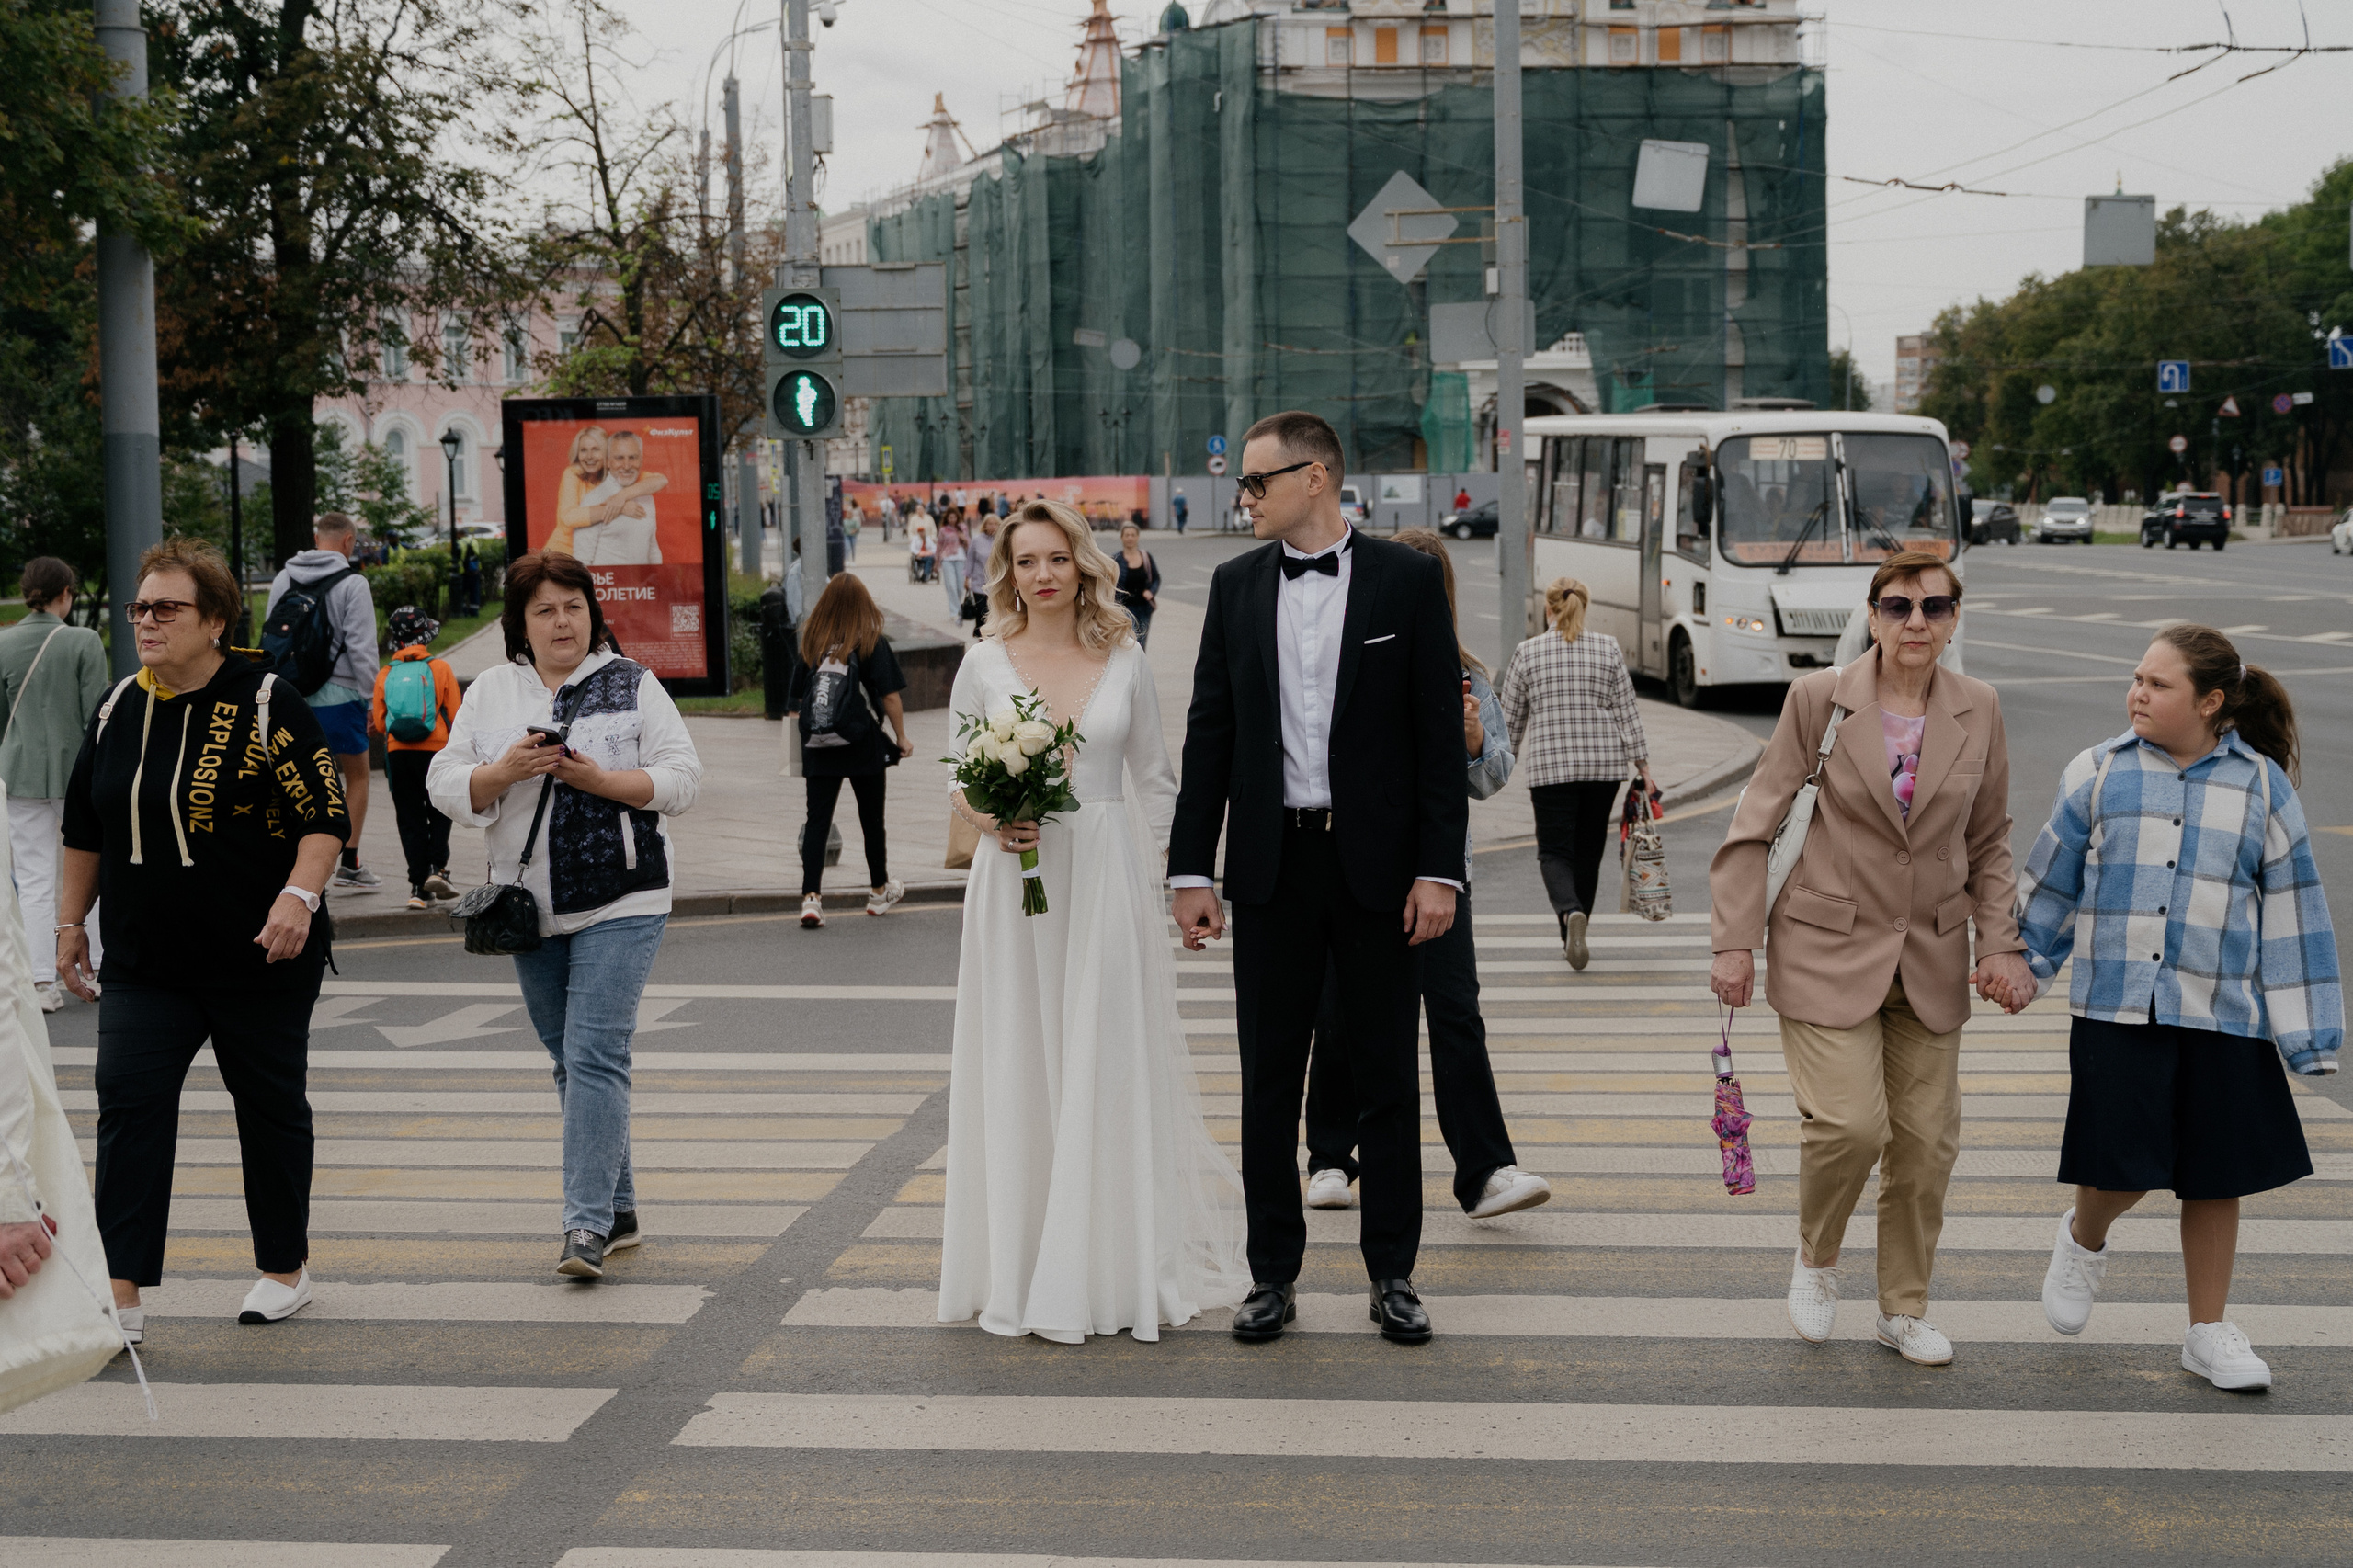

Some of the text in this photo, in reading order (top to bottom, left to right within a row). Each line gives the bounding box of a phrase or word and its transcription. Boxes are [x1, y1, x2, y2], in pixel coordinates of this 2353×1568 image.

[779, 305, 825, 347] 20
[1779, 438, 1797, 459] 70
[816, 676, 831, 706] NIKE
[188, 701, 239, 833] EXPLOSIONZ
[313, 747, 345, 817] VISUAL
[232, 803, 254, 817] X
